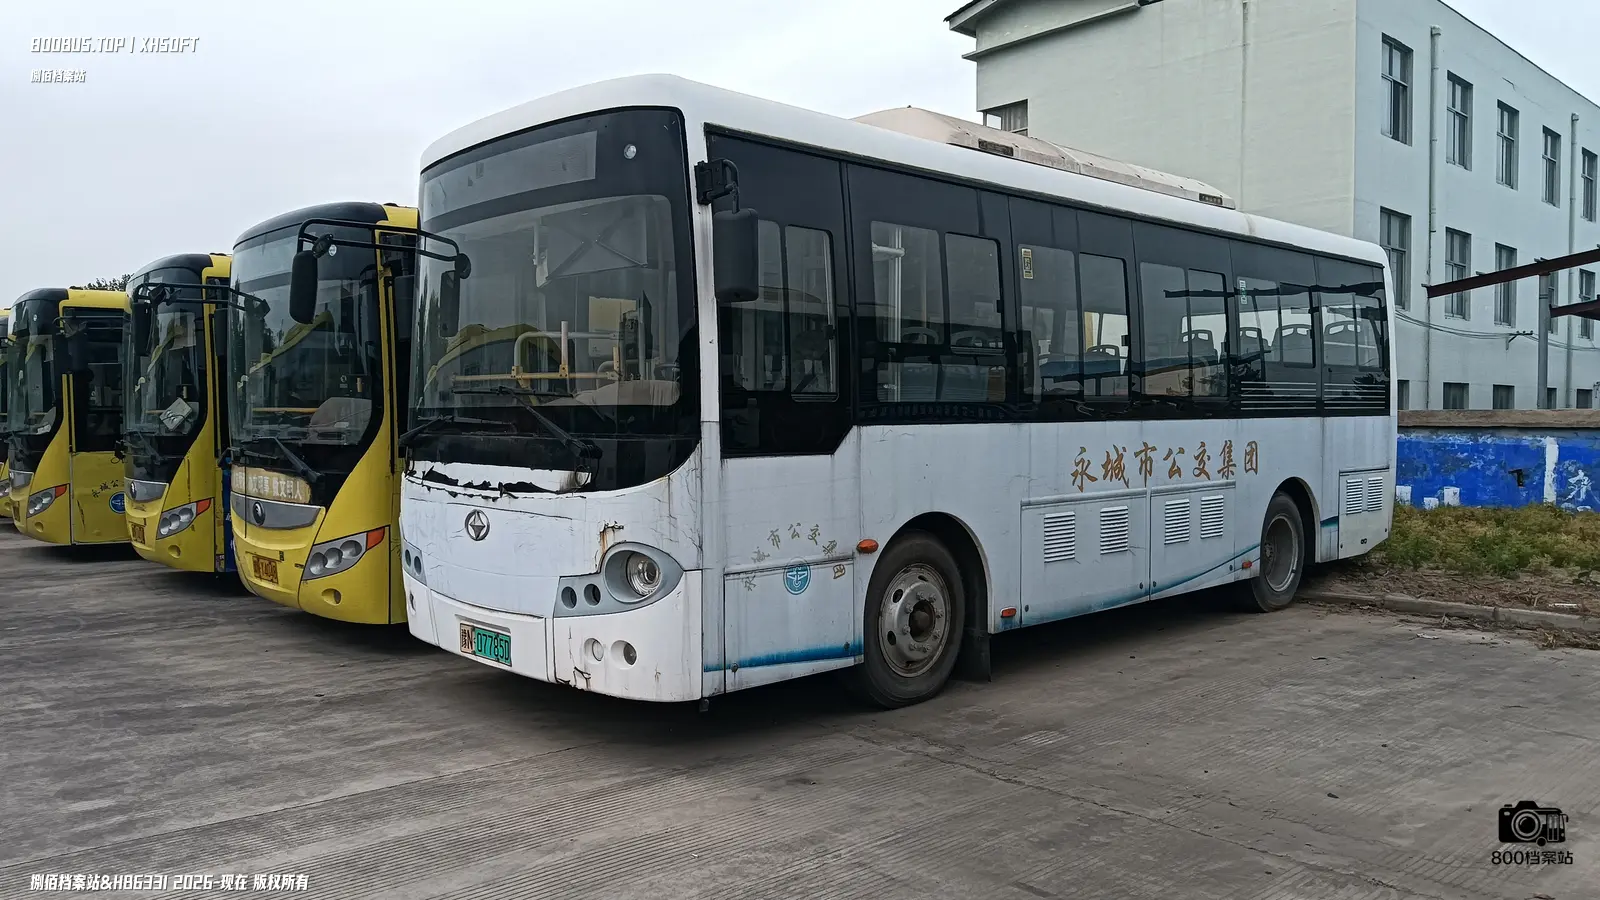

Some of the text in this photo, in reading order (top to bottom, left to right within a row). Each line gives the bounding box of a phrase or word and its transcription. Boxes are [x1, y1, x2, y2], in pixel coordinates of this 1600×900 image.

[1070, 440, 1259, 493] 永城市公交集团
